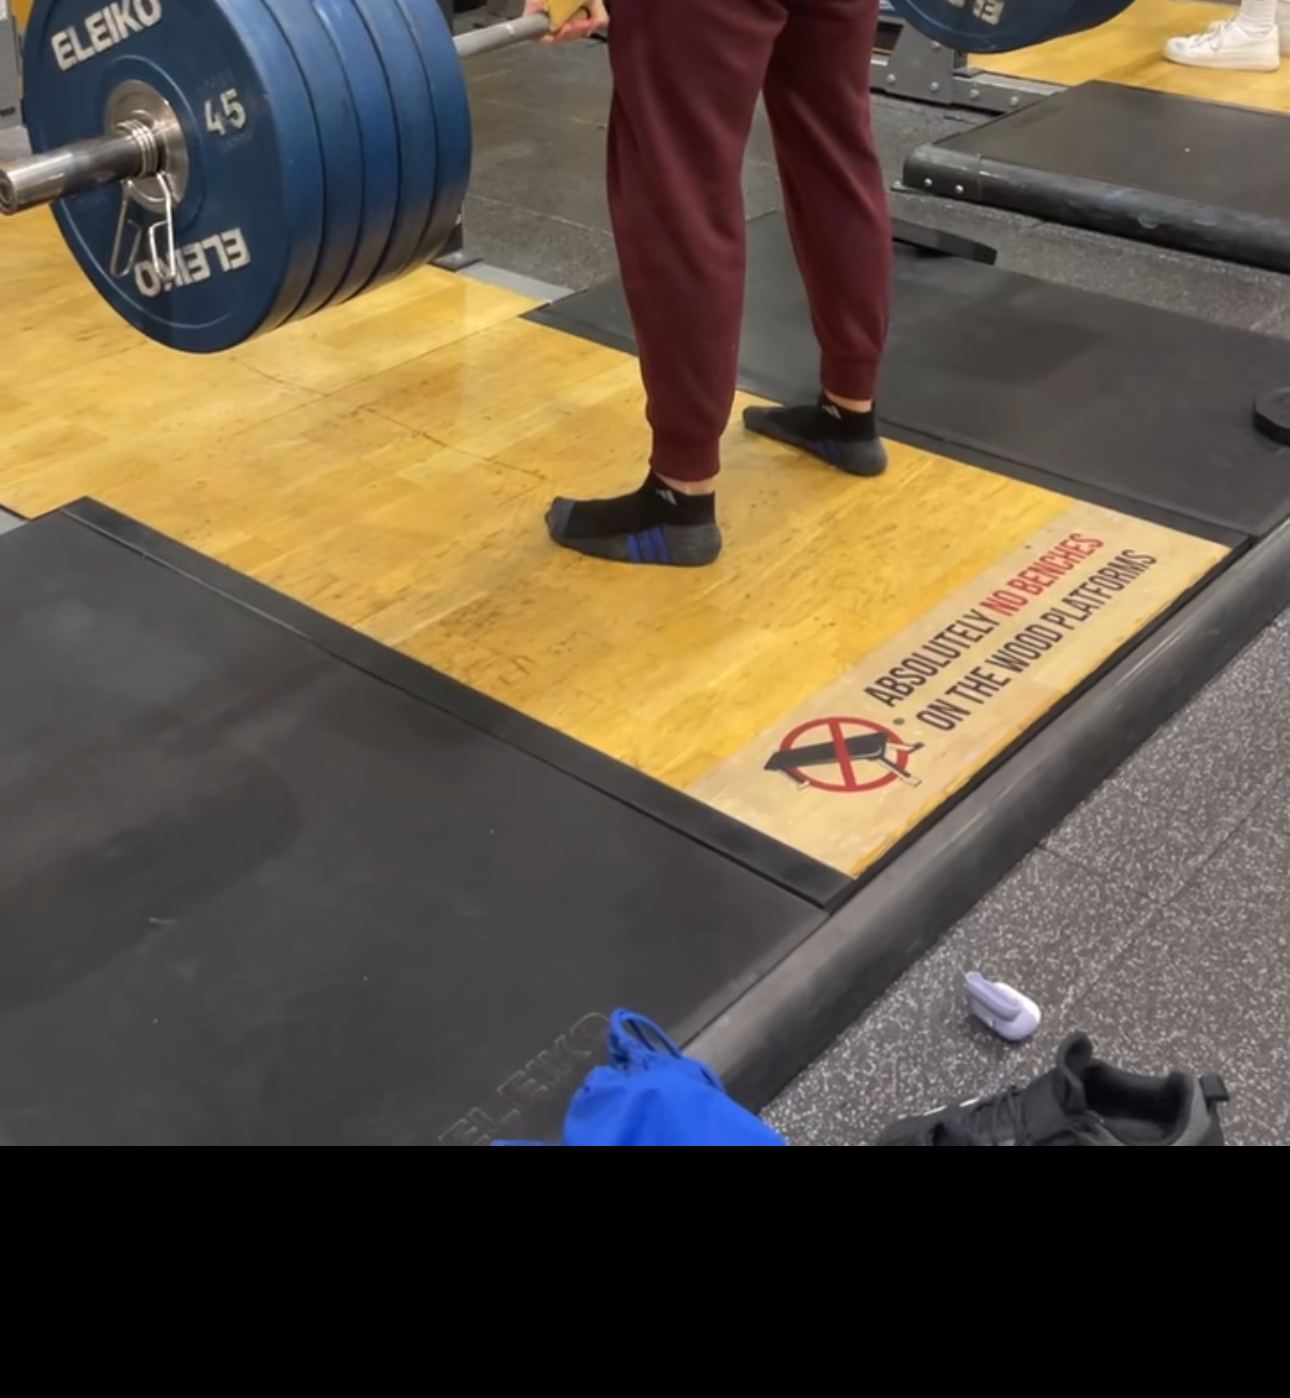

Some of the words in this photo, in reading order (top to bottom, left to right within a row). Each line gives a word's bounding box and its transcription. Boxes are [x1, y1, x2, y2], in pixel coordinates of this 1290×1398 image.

[204, 88, 247, 136] 45
[863, 608, 1000, 708] ABSOLUTELY
[978, 589, 1029, 617] NO
[1006, 533, 1104, 597] BENCHES
[916, 698, 972, 732] ON
[945, 666, 1012, 705] THE
[984, 623, 1064, 674] WOOD
[1039, 549, 1158, 631] PLATFORMS
